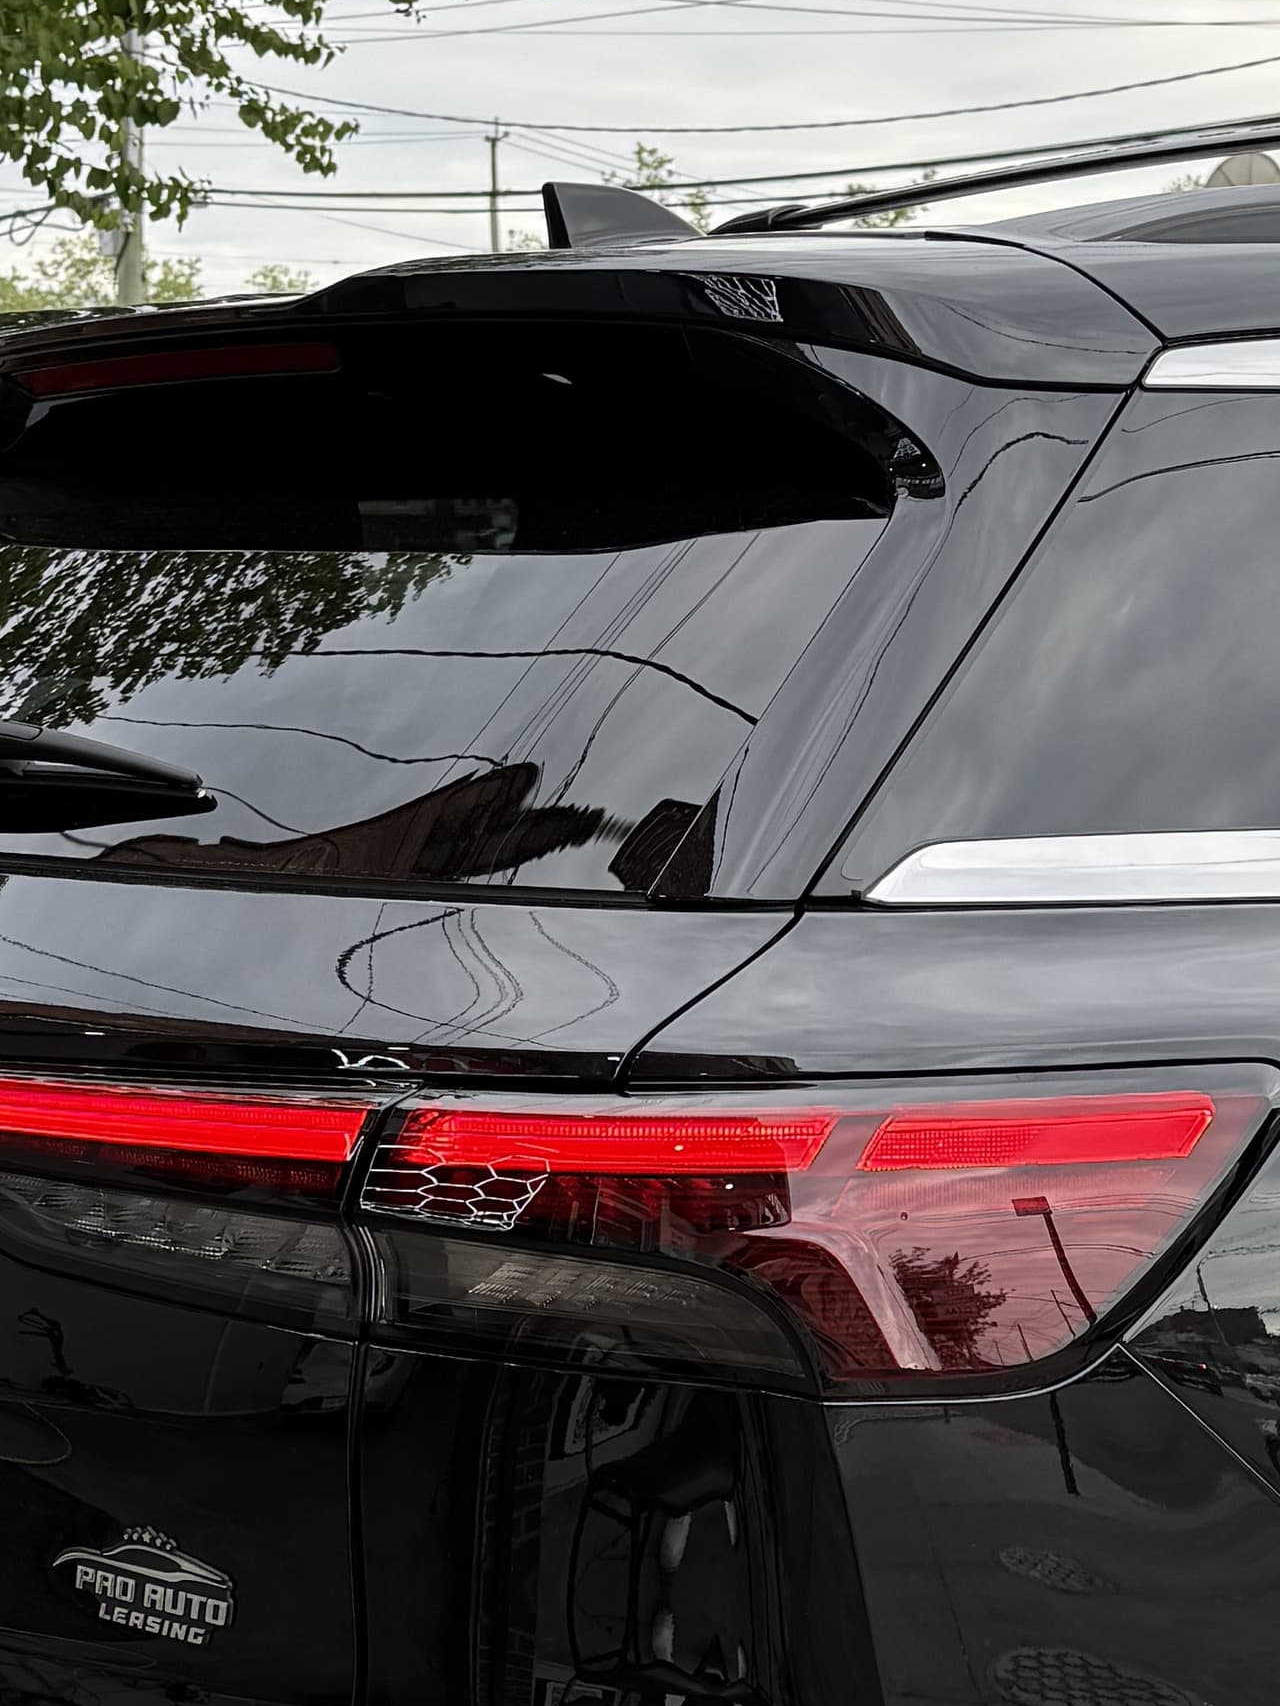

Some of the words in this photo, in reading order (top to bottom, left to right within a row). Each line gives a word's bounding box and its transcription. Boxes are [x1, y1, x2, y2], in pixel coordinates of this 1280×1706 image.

[75, 1565, 136, 1603] PRO
[143, 1583, 229, 1627] AUTO
[99, 1603, 206, 1645] LEASING
